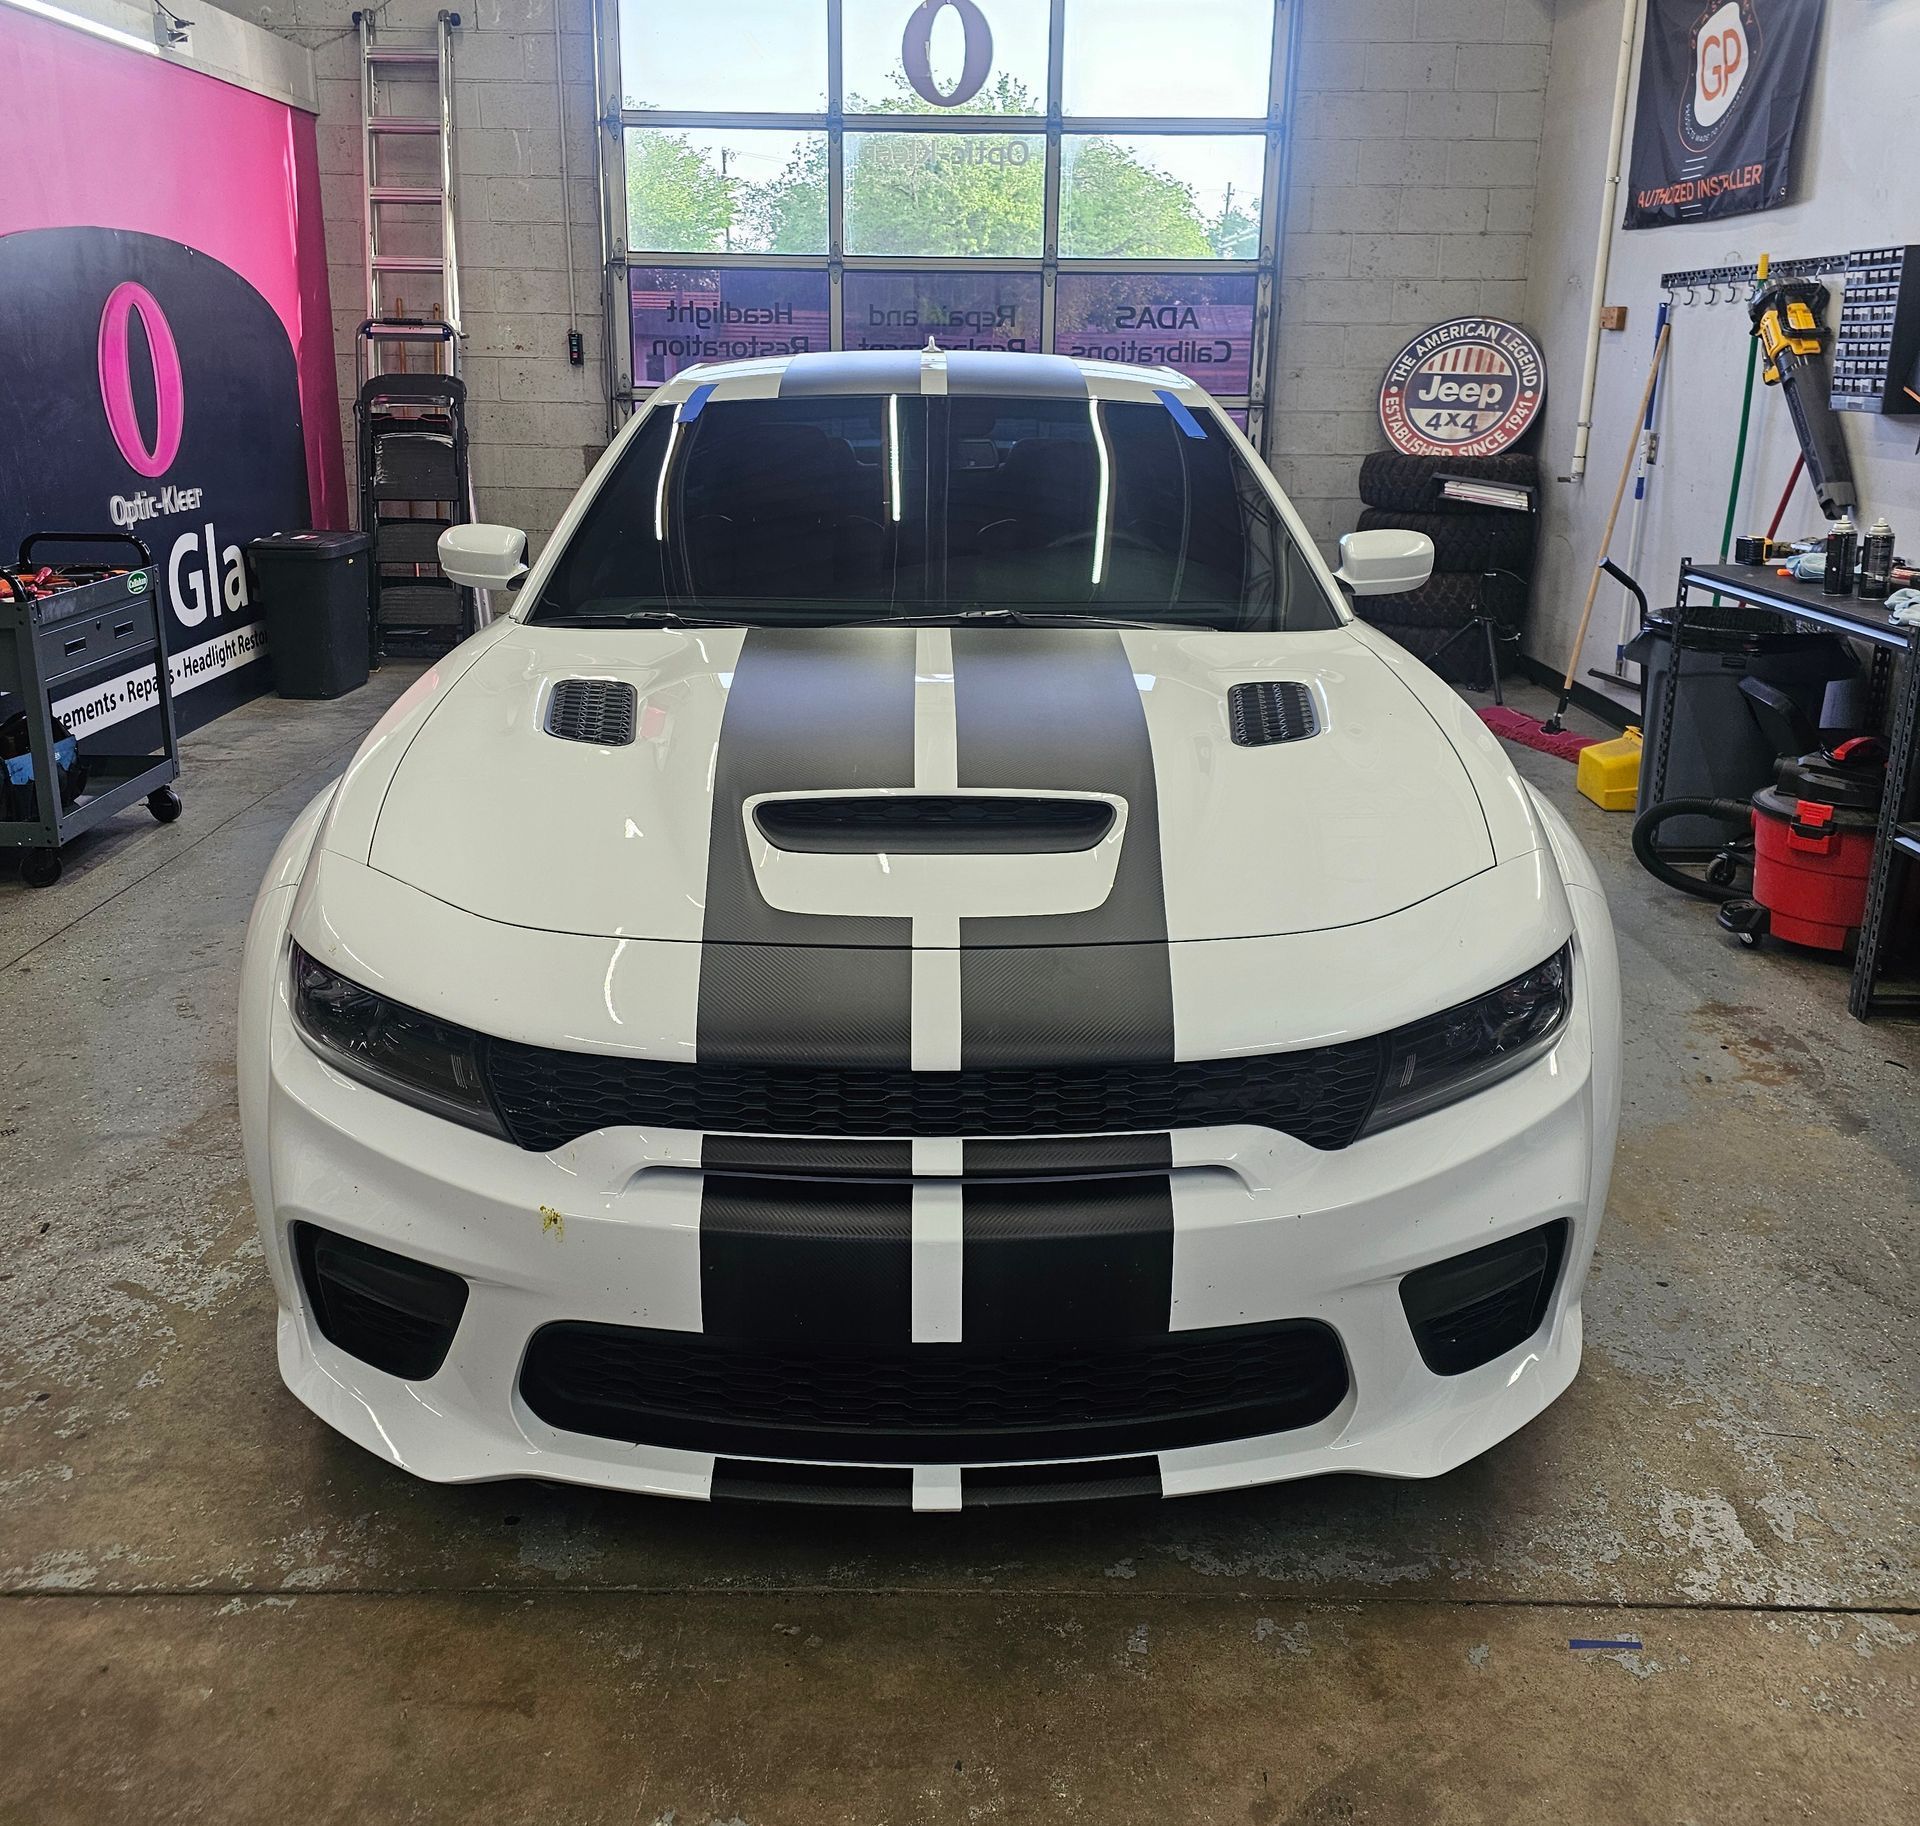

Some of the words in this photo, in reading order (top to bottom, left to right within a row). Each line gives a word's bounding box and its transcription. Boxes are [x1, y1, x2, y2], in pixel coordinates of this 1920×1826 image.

[1701, 28, 1742, 101] GP
[1391, 355, 1416, 383] THE
[1416, 323, 1501, 357] AMERICAN
[1500, 332, 1538, 387] LEGEND
[1418, 375, 1503, 409] Jeep
[1458, 431, 1508, 456] SINCE
[1505, 400, 1533, 431] 1941
[110, 485, 203, 530] Optic-Kleer
[168, 522, 281, 628] Gla
[127, 668, 174, 703] Repas
[183, 639, 236, 678] Headlight
